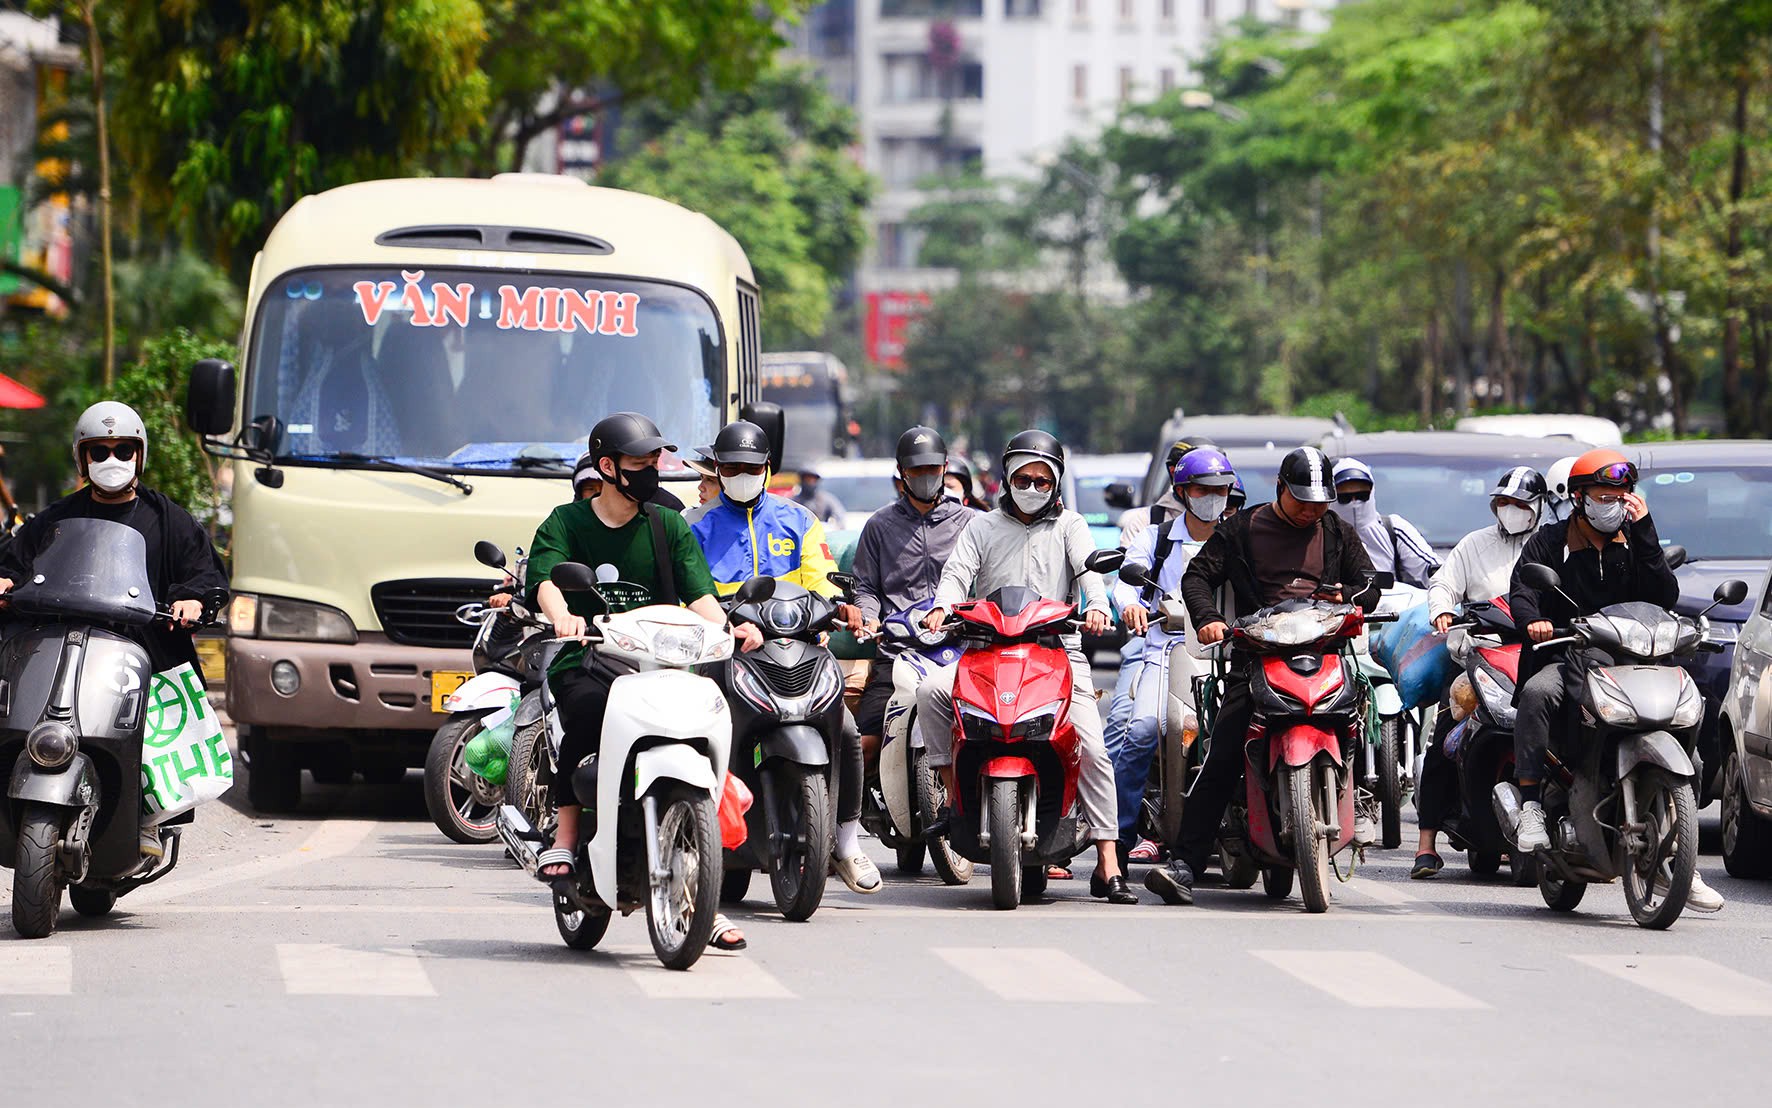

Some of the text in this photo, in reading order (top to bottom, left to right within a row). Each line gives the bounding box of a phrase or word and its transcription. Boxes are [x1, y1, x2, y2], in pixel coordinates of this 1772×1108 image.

[353, 269, 640, 337] VĂN MINH
[767, 532, 796, 557] be
